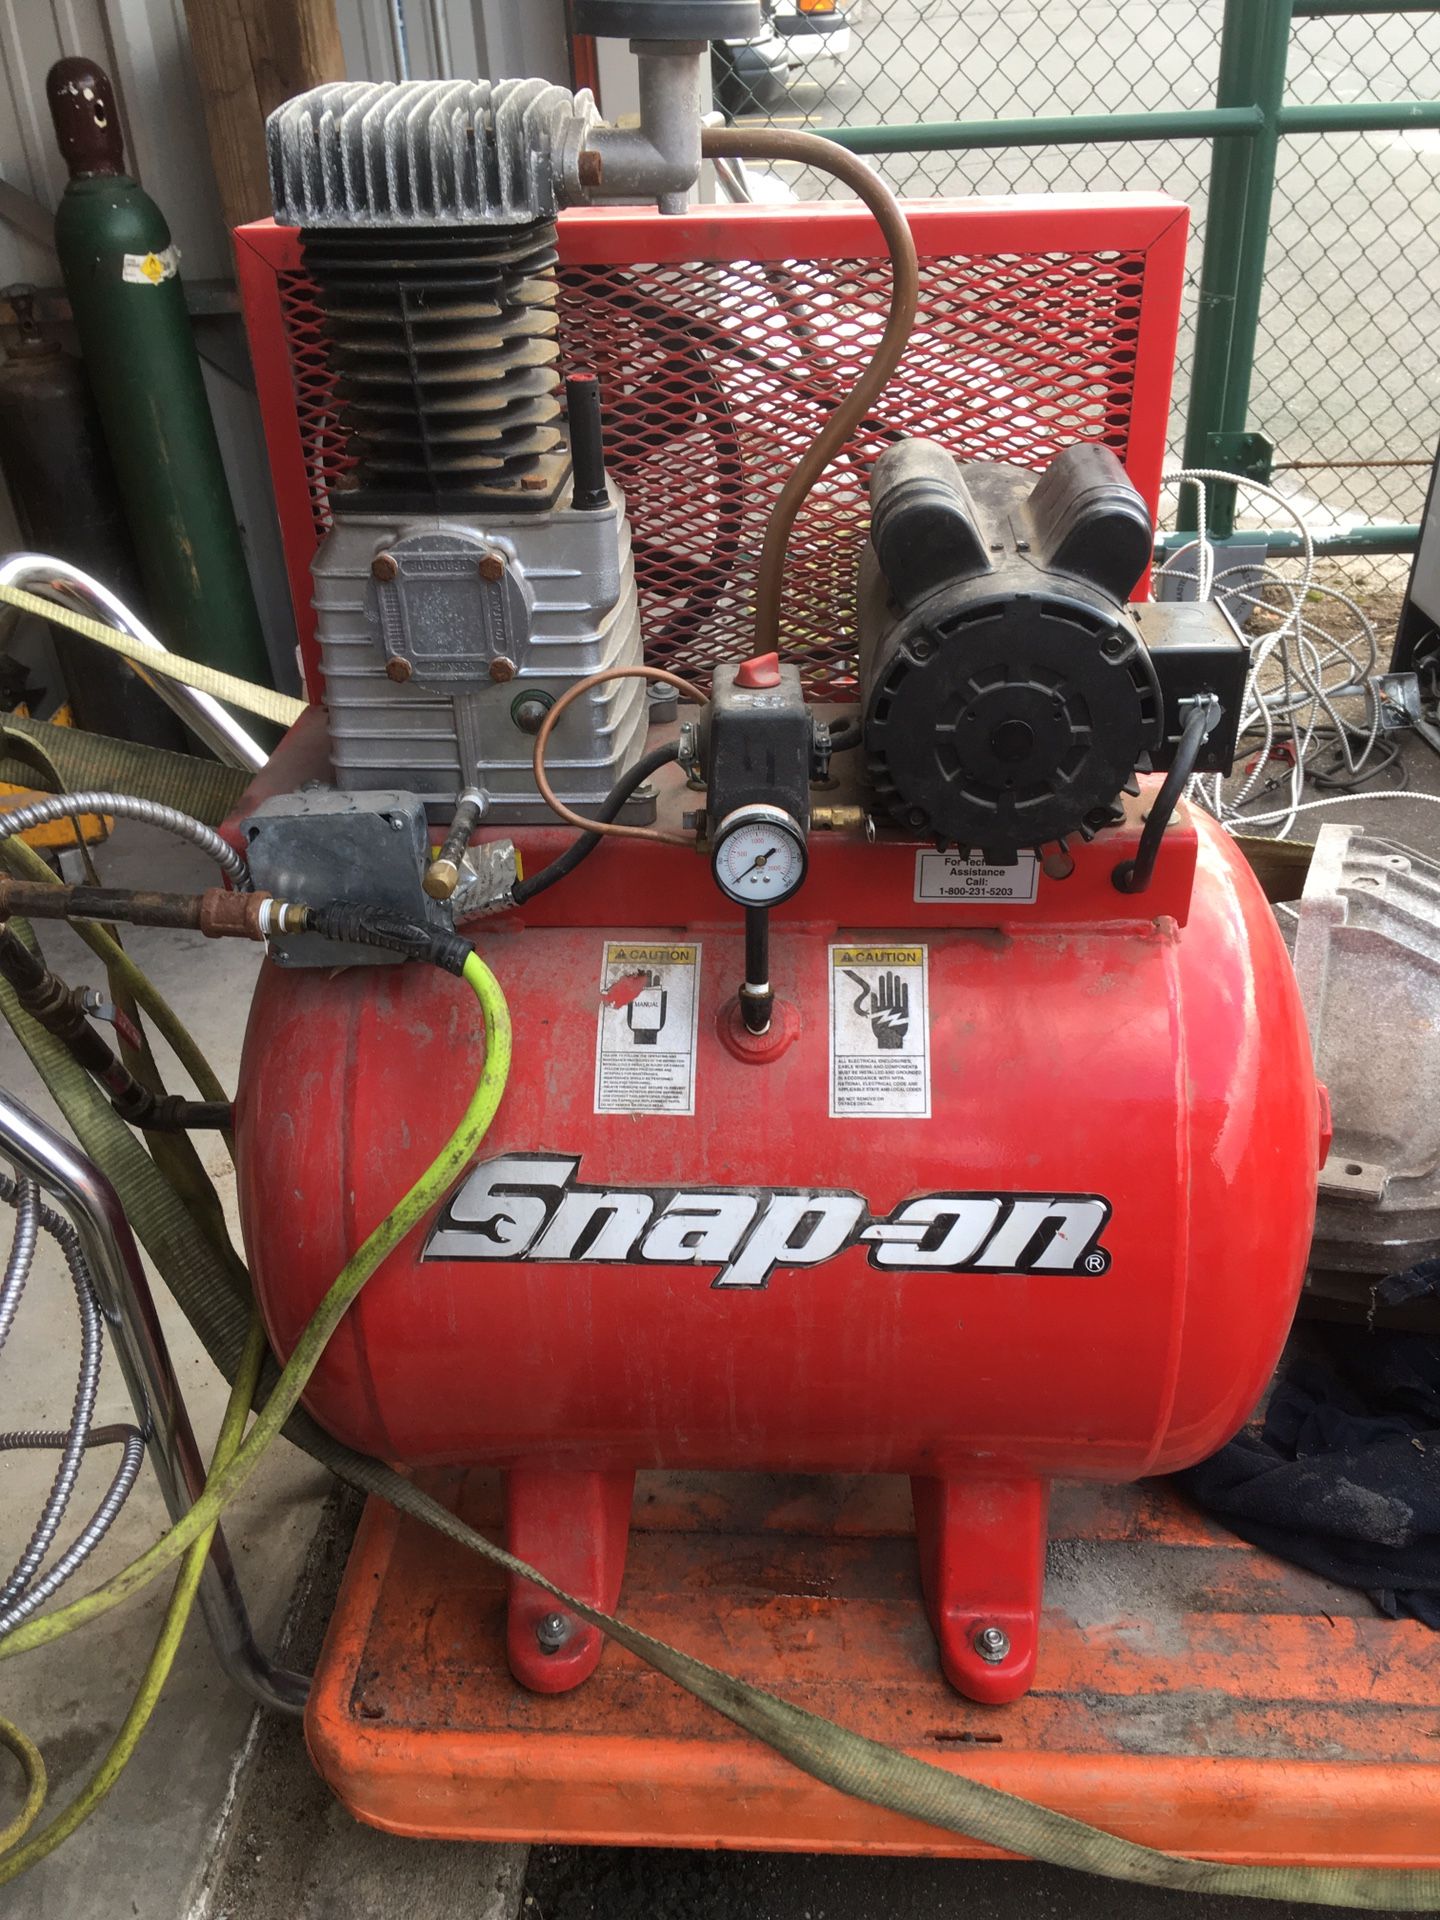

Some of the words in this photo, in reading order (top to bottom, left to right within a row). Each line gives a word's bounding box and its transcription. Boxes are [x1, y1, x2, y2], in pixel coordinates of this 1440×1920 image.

[950, 868, 1005, 876] Assistance
[965, 877, 988, 886] Call:
[939, 887, 1013, 896] 1-800-231-5203
[630, 951, 690, 961] CAUTION
[855, 952, 917, 962] CAUTION
